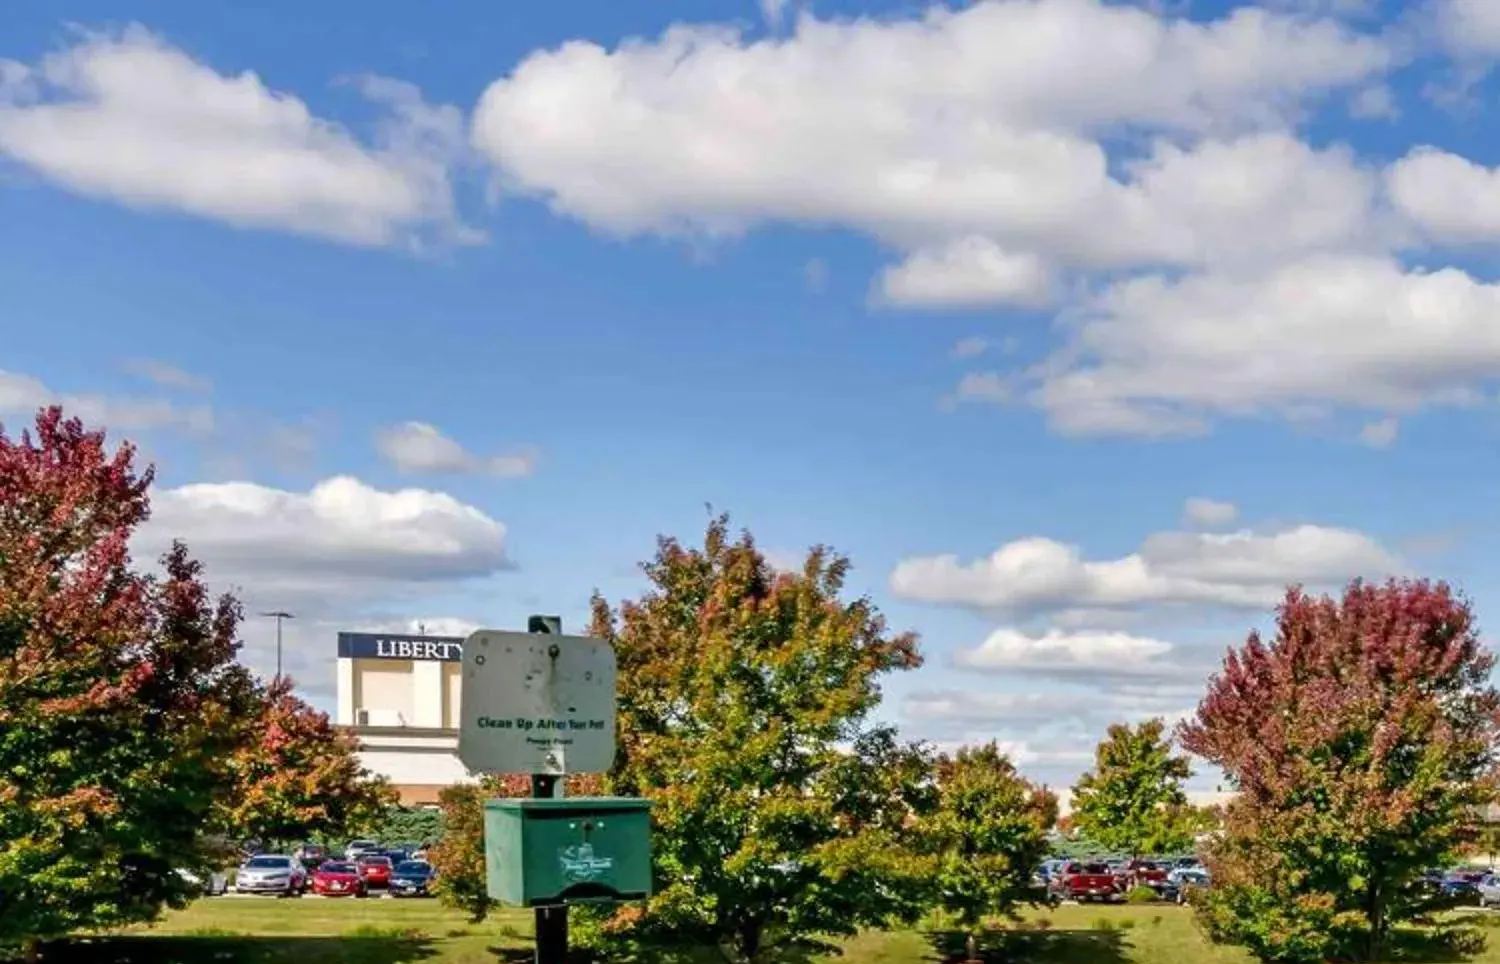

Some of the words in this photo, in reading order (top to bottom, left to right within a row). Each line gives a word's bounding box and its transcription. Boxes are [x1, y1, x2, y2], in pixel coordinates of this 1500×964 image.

[477, 716, 512, 729] Clean
[516, 718, 533, 731] Up
[536, 719, 566, 729] After
